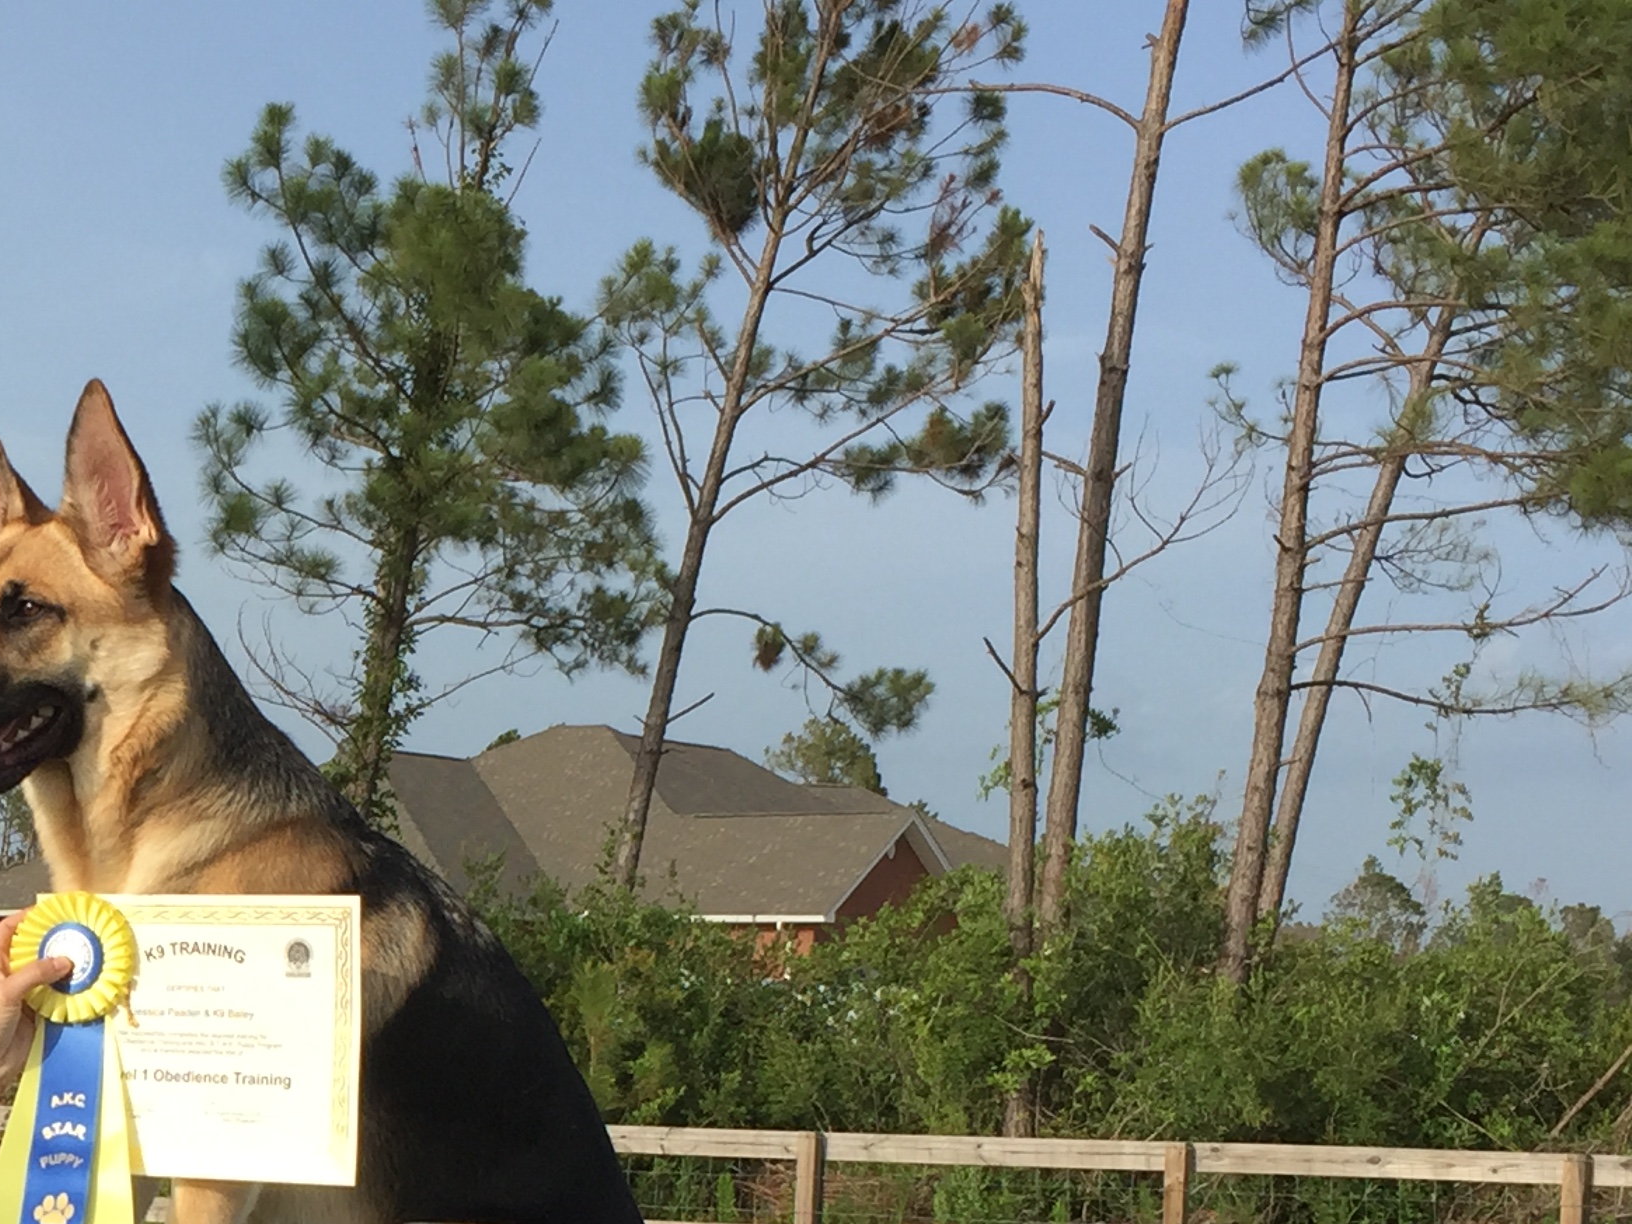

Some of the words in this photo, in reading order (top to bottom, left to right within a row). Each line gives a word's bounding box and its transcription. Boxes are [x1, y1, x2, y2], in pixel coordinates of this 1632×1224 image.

[144, 944, 165, 963] K9
[169, 941, 247, 964] TRAINING
[153, 1069, 229, 1085] Obedience
[234, 1071, 291, 1090] Training
[39, 1152, 84, 1169] PUPPY
